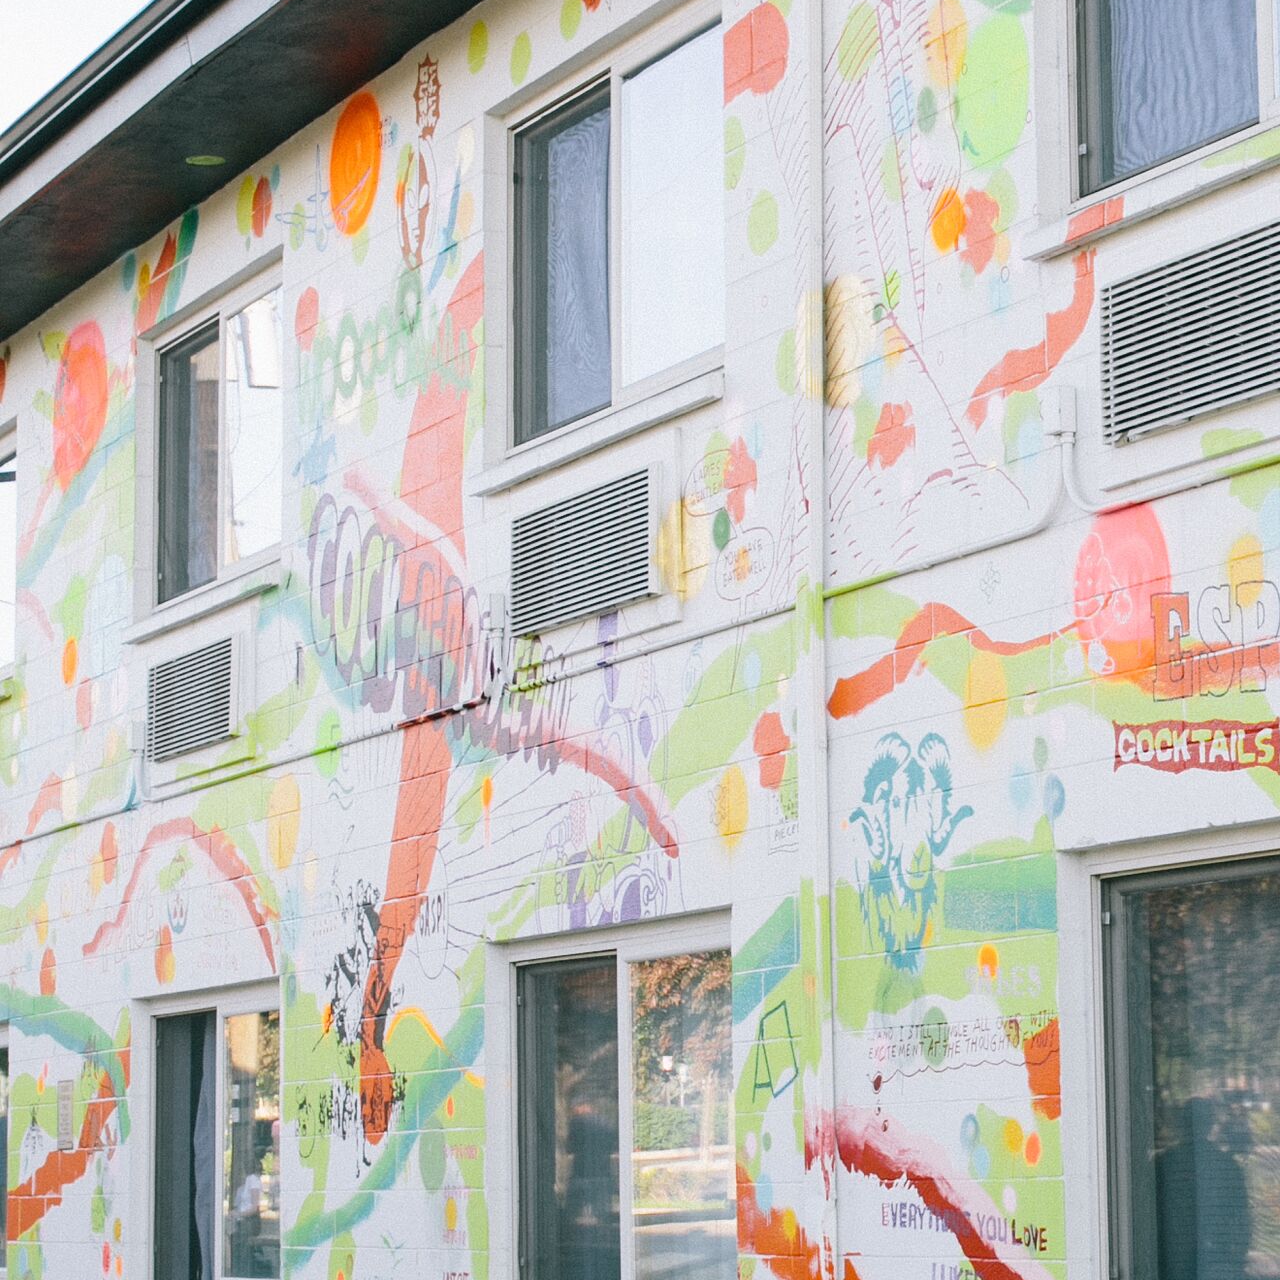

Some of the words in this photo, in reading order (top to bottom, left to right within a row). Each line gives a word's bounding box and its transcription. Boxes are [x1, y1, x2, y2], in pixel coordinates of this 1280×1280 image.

[1117, 727, 1275, 764] COCKTAILS
[882, 1202, 972, 1237] EVERYTHING
[976, 1212, 1008, 1244] YOU
